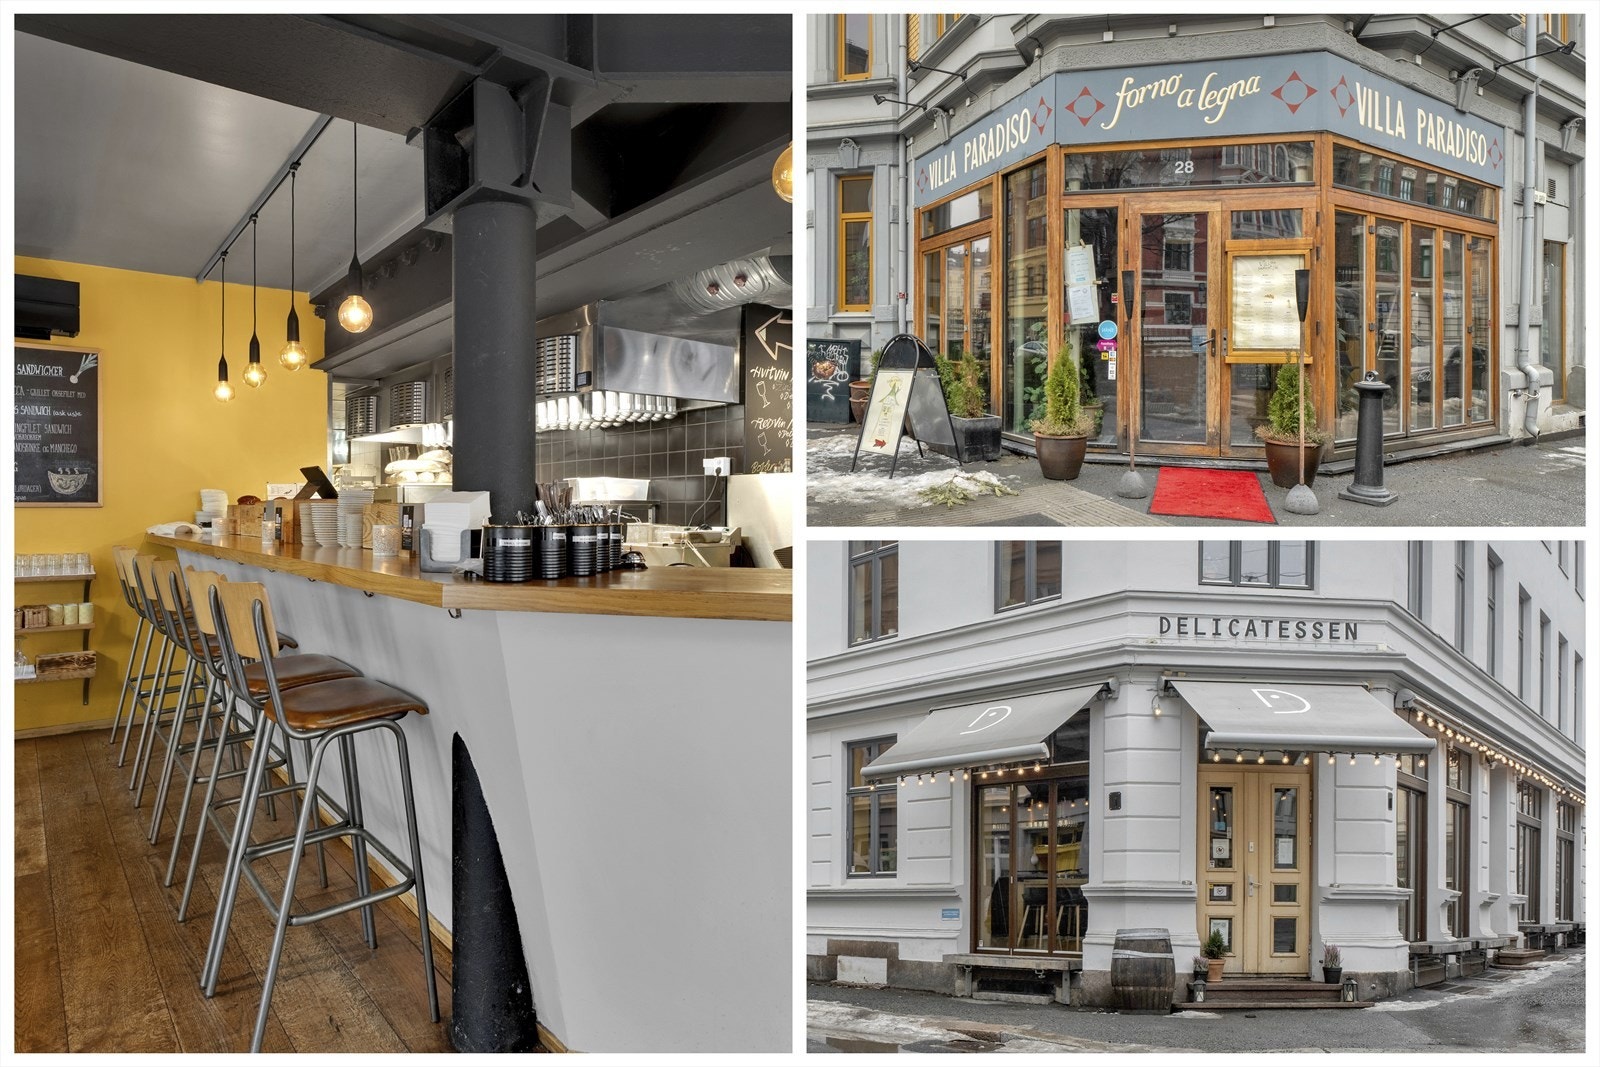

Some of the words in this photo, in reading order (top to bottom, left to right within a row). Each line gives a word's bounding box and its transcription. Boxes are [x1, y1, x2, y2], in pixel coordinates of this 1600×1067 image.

[1101, 73, 1183, 130] forno
[1177, 87, 1195, 108] a
[1198, 72, 1261, 125] legna
[1355, 81, 1406, 140] VILLA
[1416, 108, 1487, 167] PARADISO
[928, 155, 957, 191] VILLA
[964, 108, 1031, 174] PARADISO
[1174, 160, 1194, 174] 28
[16, 364, 63, 376] SANDWICHER
[20, 405, 51, 416] SANDWICH
[44, 424, 72, 435] SANDWICH
[1159, 616, 1358, 640] DELICATESSEN
